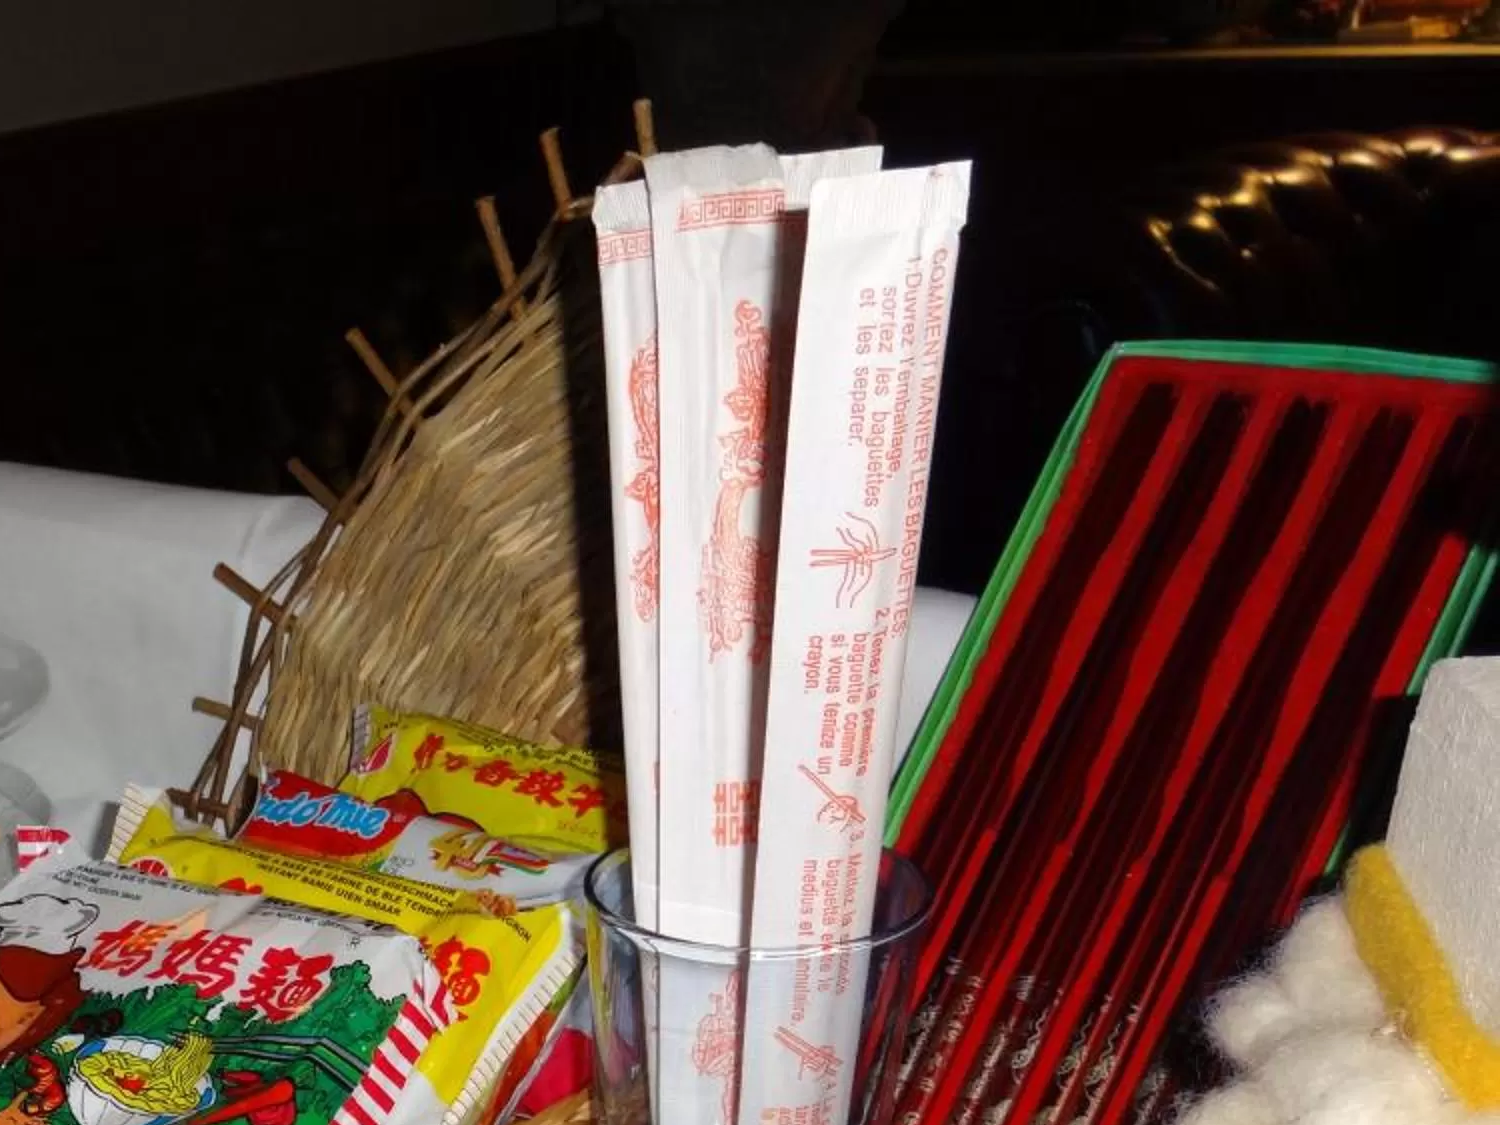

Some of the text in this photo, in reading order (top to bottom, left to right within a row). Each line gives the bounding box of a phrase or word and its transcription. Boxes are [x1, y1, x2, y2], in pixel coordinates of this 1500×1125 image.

[860, 288, 876, 307] et
[922, 248, 947, 369] COMMENT
[856, 326, 874, 355] les
[874, 368, 894, 396] les
[912, 375, 936, 463] MANIER
[864, 411, 888, 508] baguettes
[907, 469, 926, 510] LES
[832, 634, 845, 648] si
[826, 655, 843, 693] vous
[840, 633, 869, 767] baguette comme
[818, 757, 834, 775] un
[75, 919, 334, 1023] 媽媽麵
